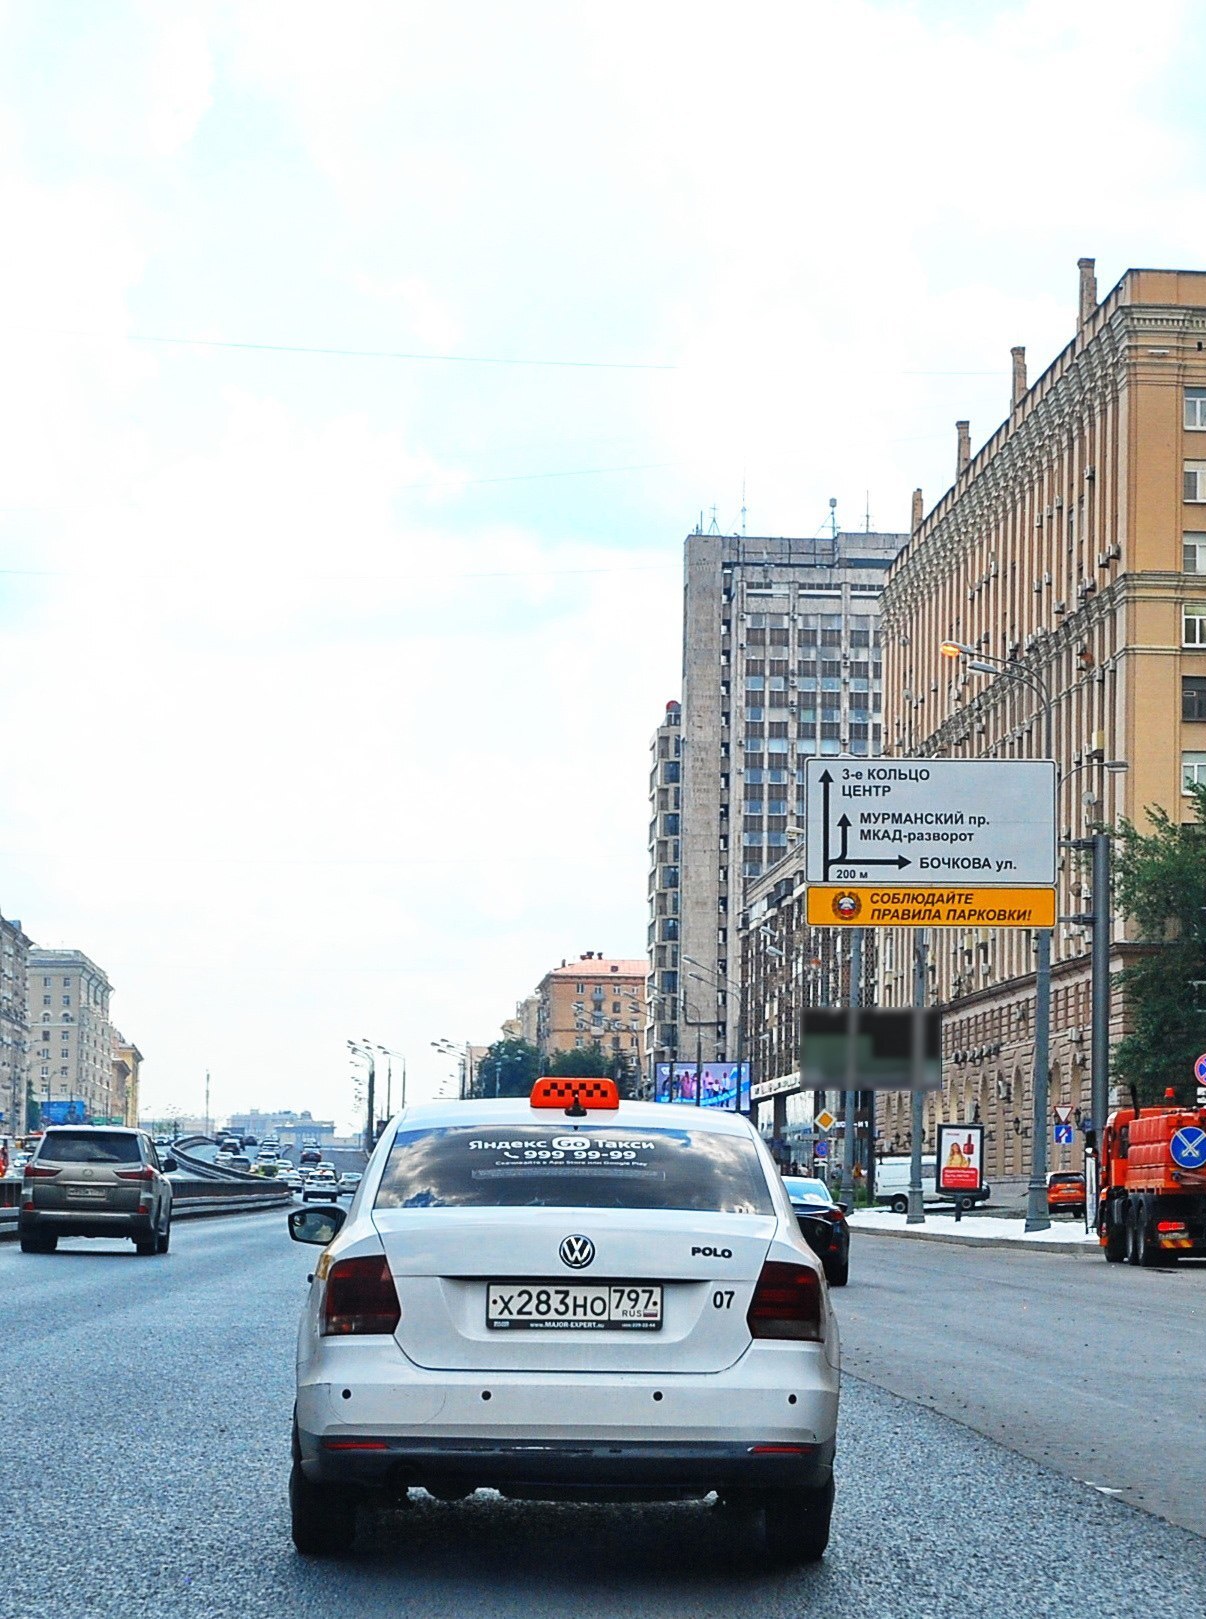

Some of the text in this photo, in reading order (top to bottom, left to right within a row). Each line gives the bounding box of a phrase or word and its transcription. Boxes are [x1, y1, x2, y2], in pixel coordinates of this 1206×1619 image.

[841, 768, 930, 783] 3-е КОЛЬЦО
[841, 784, 892, 798] ЦЕНТР
[859, 811, 990, 827] МУРМАНСКИЙ пр.
[859, 829, 975, 843] МКАД-разворот
[919, 857, 1017, 872] БОЧКОВА ул.
[836, 869, 869, 880] 200 м
[869, 891, 974, 906] СОБЛЮДАЙТЕ
[870, 908, 1032, 922] ПРАВИЛА ПАРКОВКИ!
[468, 1139, 548, 1151] Яндекс
[594, 1138, 656, 1150] Такси
[523, 1150, 637, 1160] 999 99-99
[691, 1247, 733, 1259] POLO
[612, 1288, 655, 1310] 797
[712, 1290, 735, 1309] 07
[621, 1309, 642, 1317] RUS
